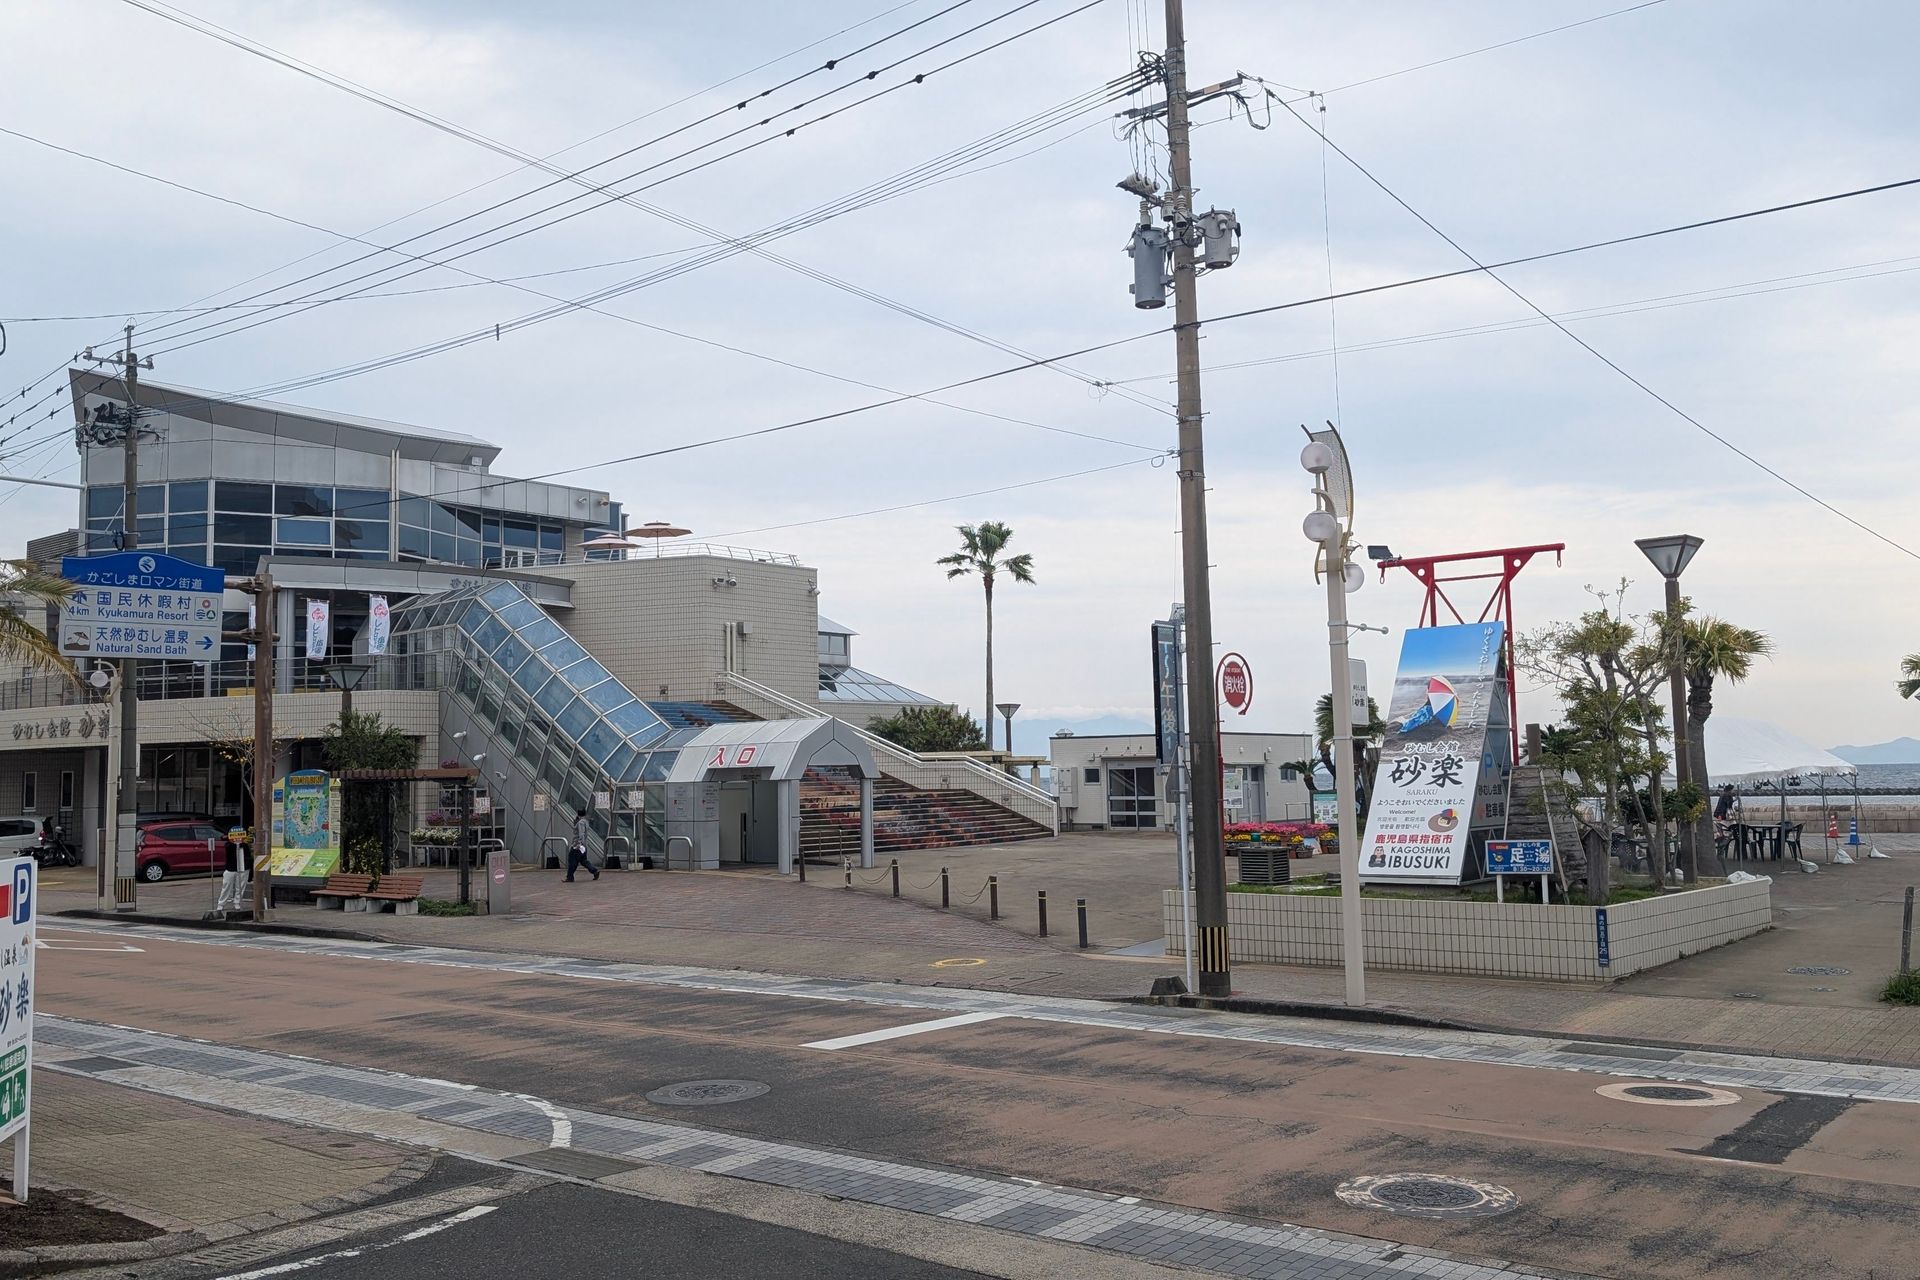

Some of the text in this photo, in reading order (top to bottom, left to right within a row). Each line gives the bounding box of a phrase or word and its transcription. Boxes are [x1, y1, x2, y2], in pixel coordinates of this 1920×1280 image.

[87, 571, 202, 590] かごしまロマン街道
[97, 591, 191, 609] 国民休暇村
[97, 607, 154, 620] Kyukamura
[157, 610, 189, 621] Resort
[95, 626, 189, 644] 天然砂むし温泉
[96, 643, 187, 655] Natural Sand Bath
[1224, 675, 1245, 693] 消火栓
[1405, 741, 1459, 753] 砂むし会館
[708, 746, 756, 767] 入口
[1388, 754, 1463, 788] 砂楽
[1485, 754, 1493, 779] P
[1375, 834, 1453, 845] 鹿児島県指宿市
[1390, 846, 1451, 854] KAGOSHIMA
[1388, 856, 1450, 869] IBUSUKI
[16, 868, 30, 921] P
